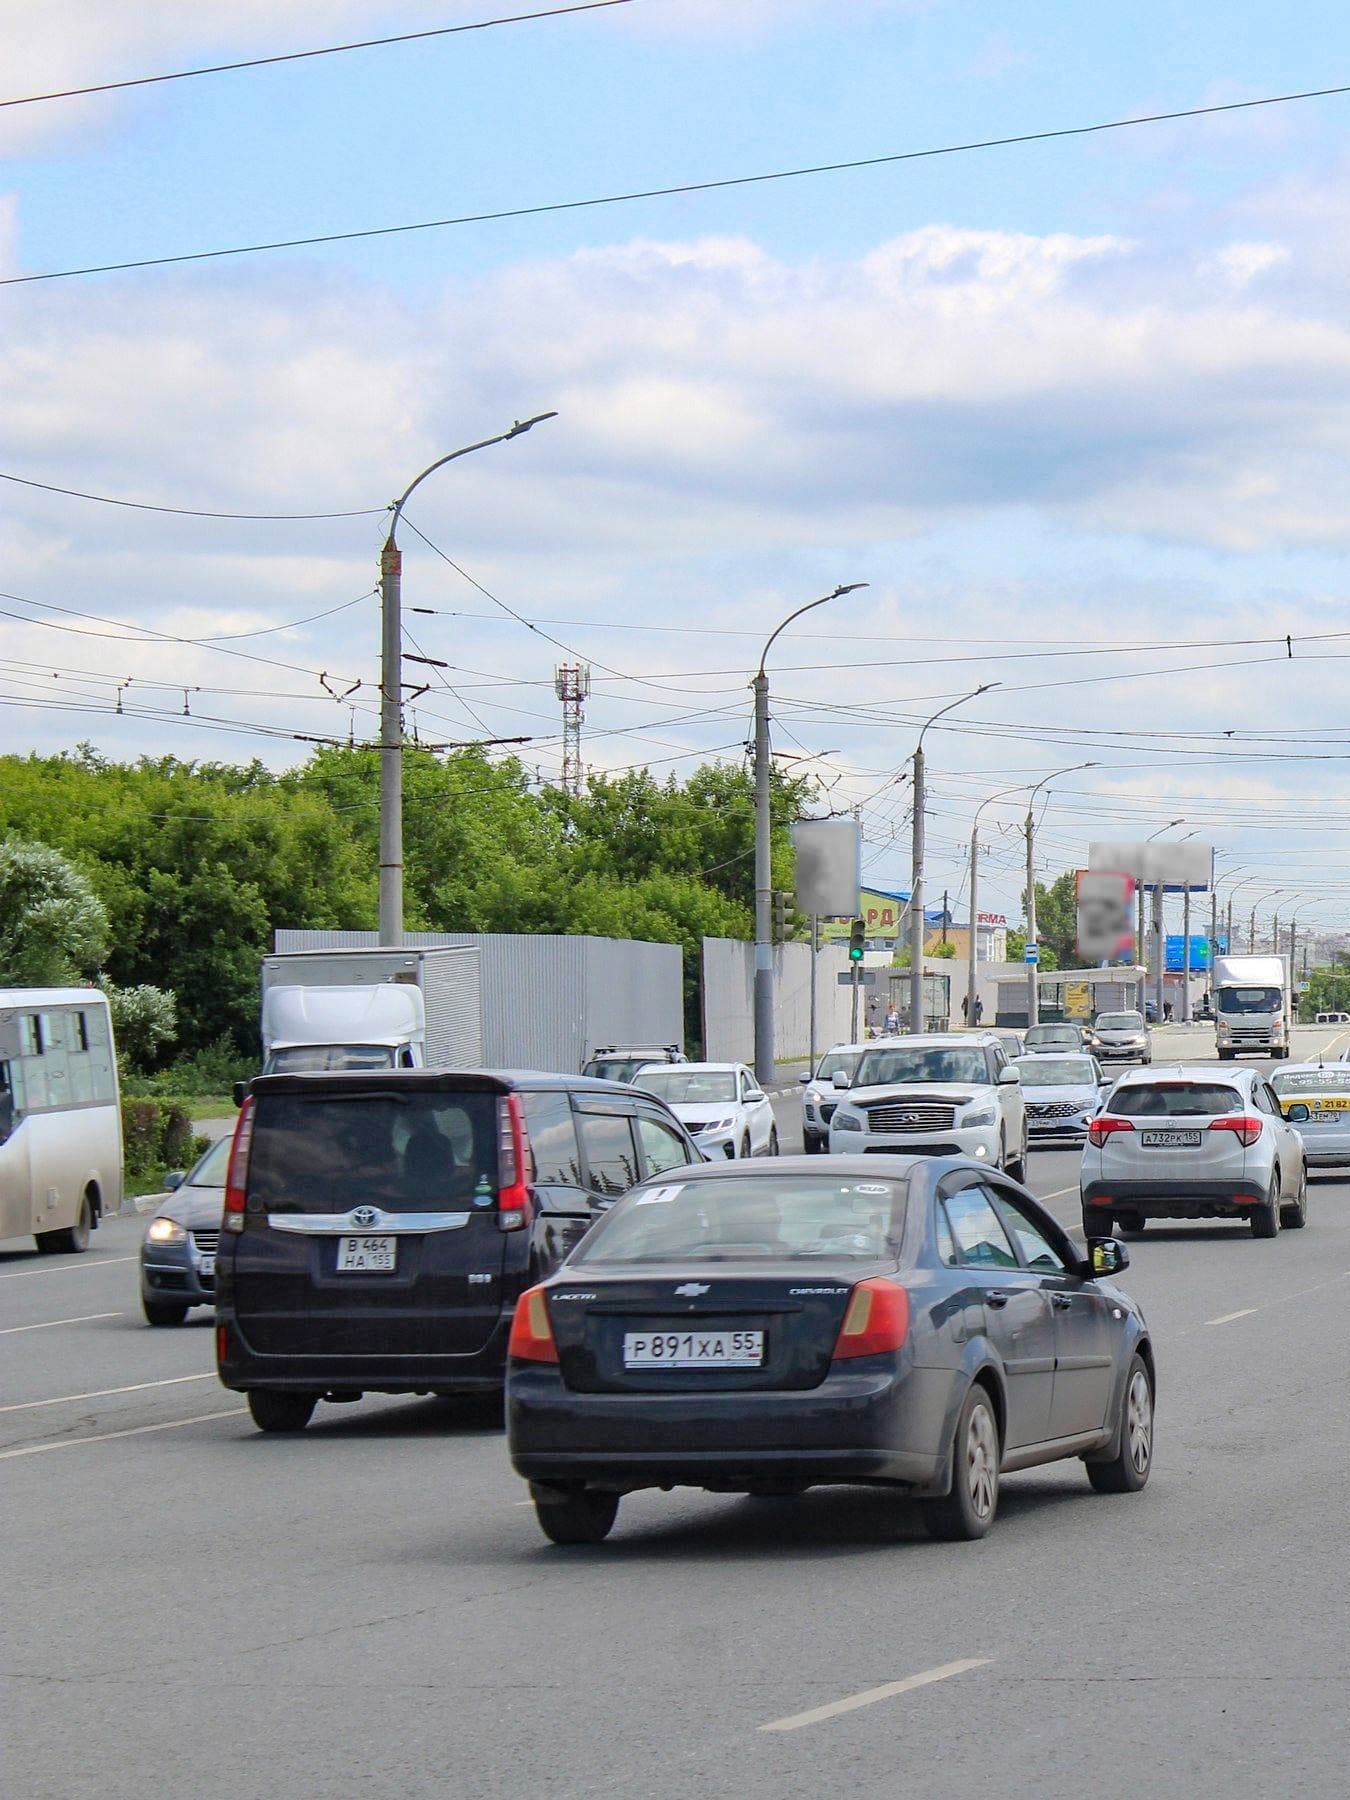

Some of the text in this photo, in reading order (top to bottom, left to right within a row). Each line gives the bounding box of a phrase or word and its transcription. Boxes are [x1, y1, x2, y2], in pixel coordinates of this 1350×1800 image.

[362, 1238, 389, 1252] 464
[788, 1287, 849, 1295] CHEVROLET
[632, 1332, 755, 1359] Р891ХА 55
